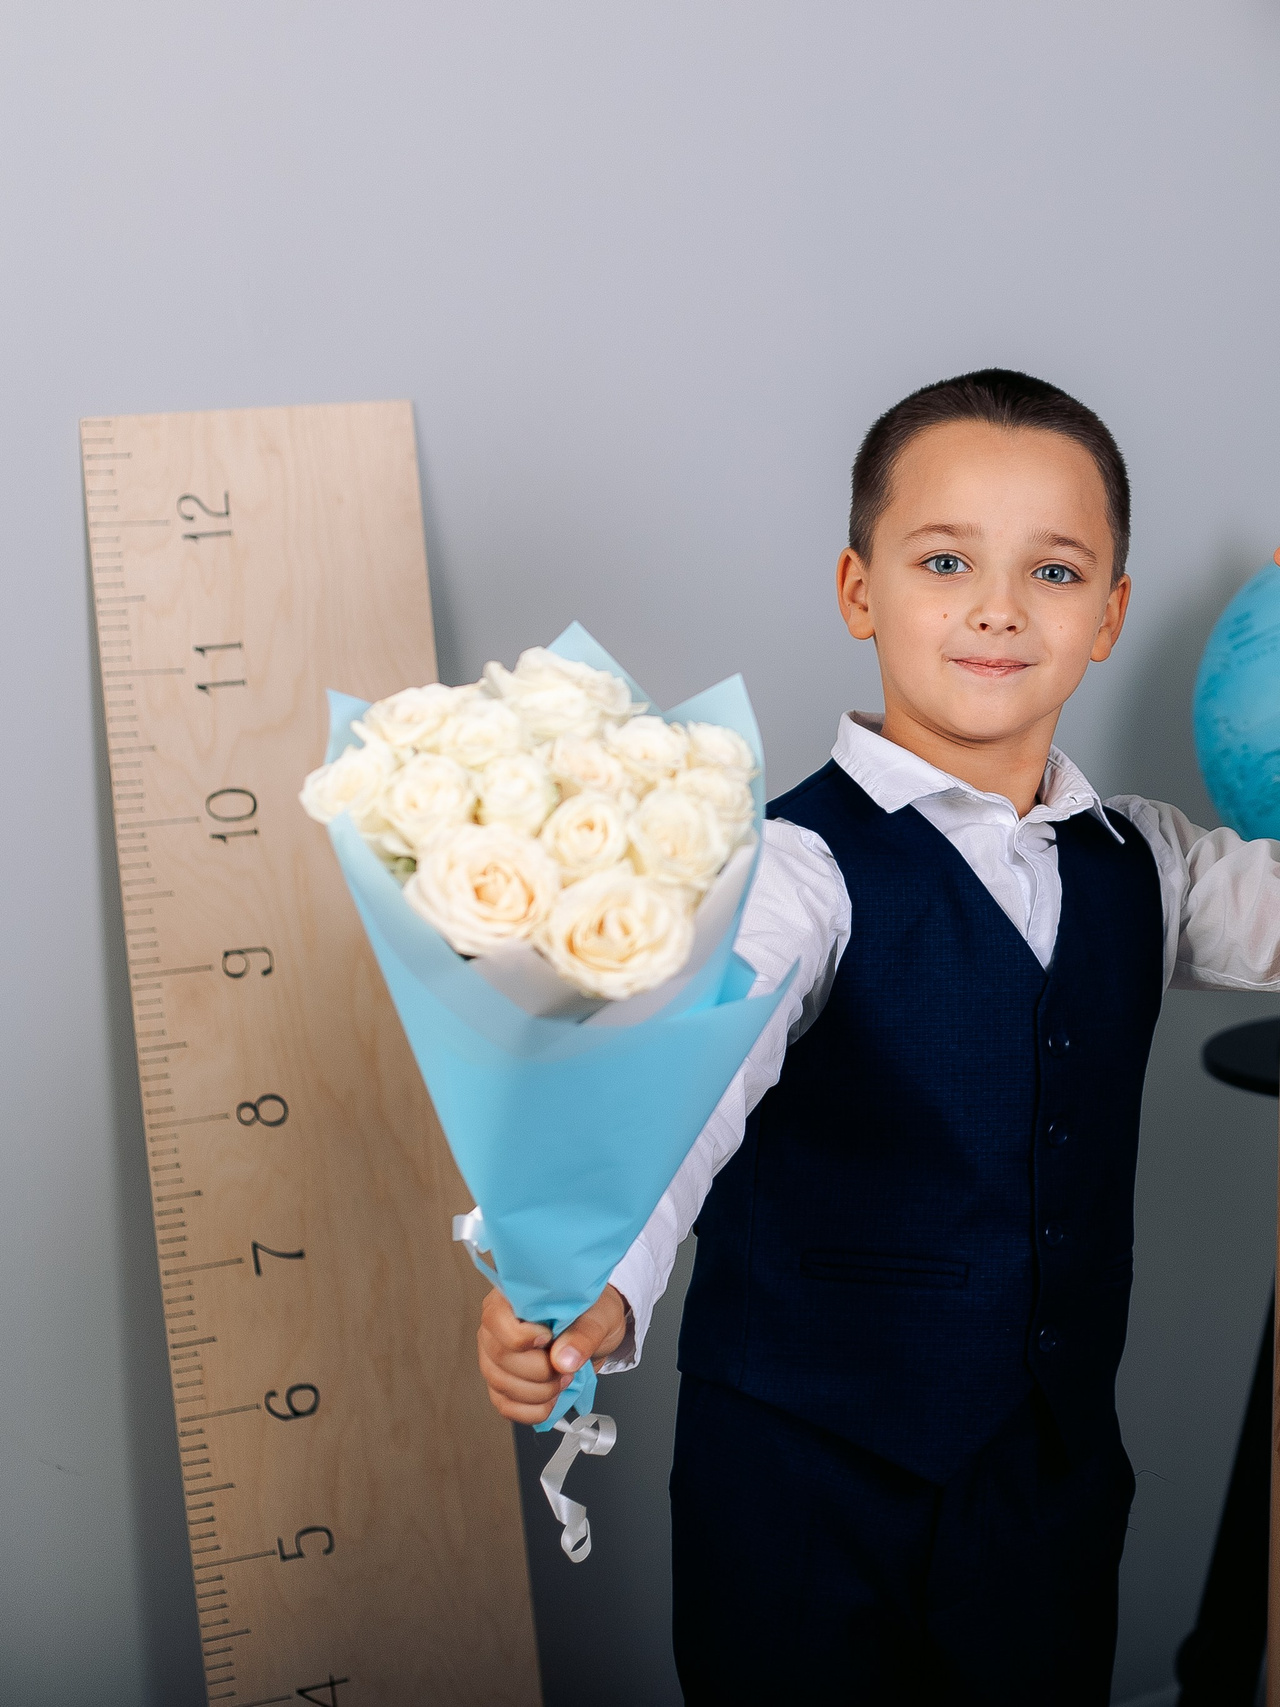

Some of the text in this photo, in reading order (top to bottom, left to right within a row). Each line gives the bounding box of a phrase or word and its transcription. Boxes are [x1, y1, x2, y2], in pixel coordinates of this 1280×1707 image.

[175, 490, 234, 544] 12
[193, 641, 247, 696] 11
[204, 786, 260, 845] 10
[221, 945, 276, 981] 9
[235, 1092, 290, 1128] 8
[251, 1240, 306, 1278] 7
[263, 1382, 321, 1422] 6
[276, 1525, 336, 1563] 5
[295, 1672, 350, 1707] 4
